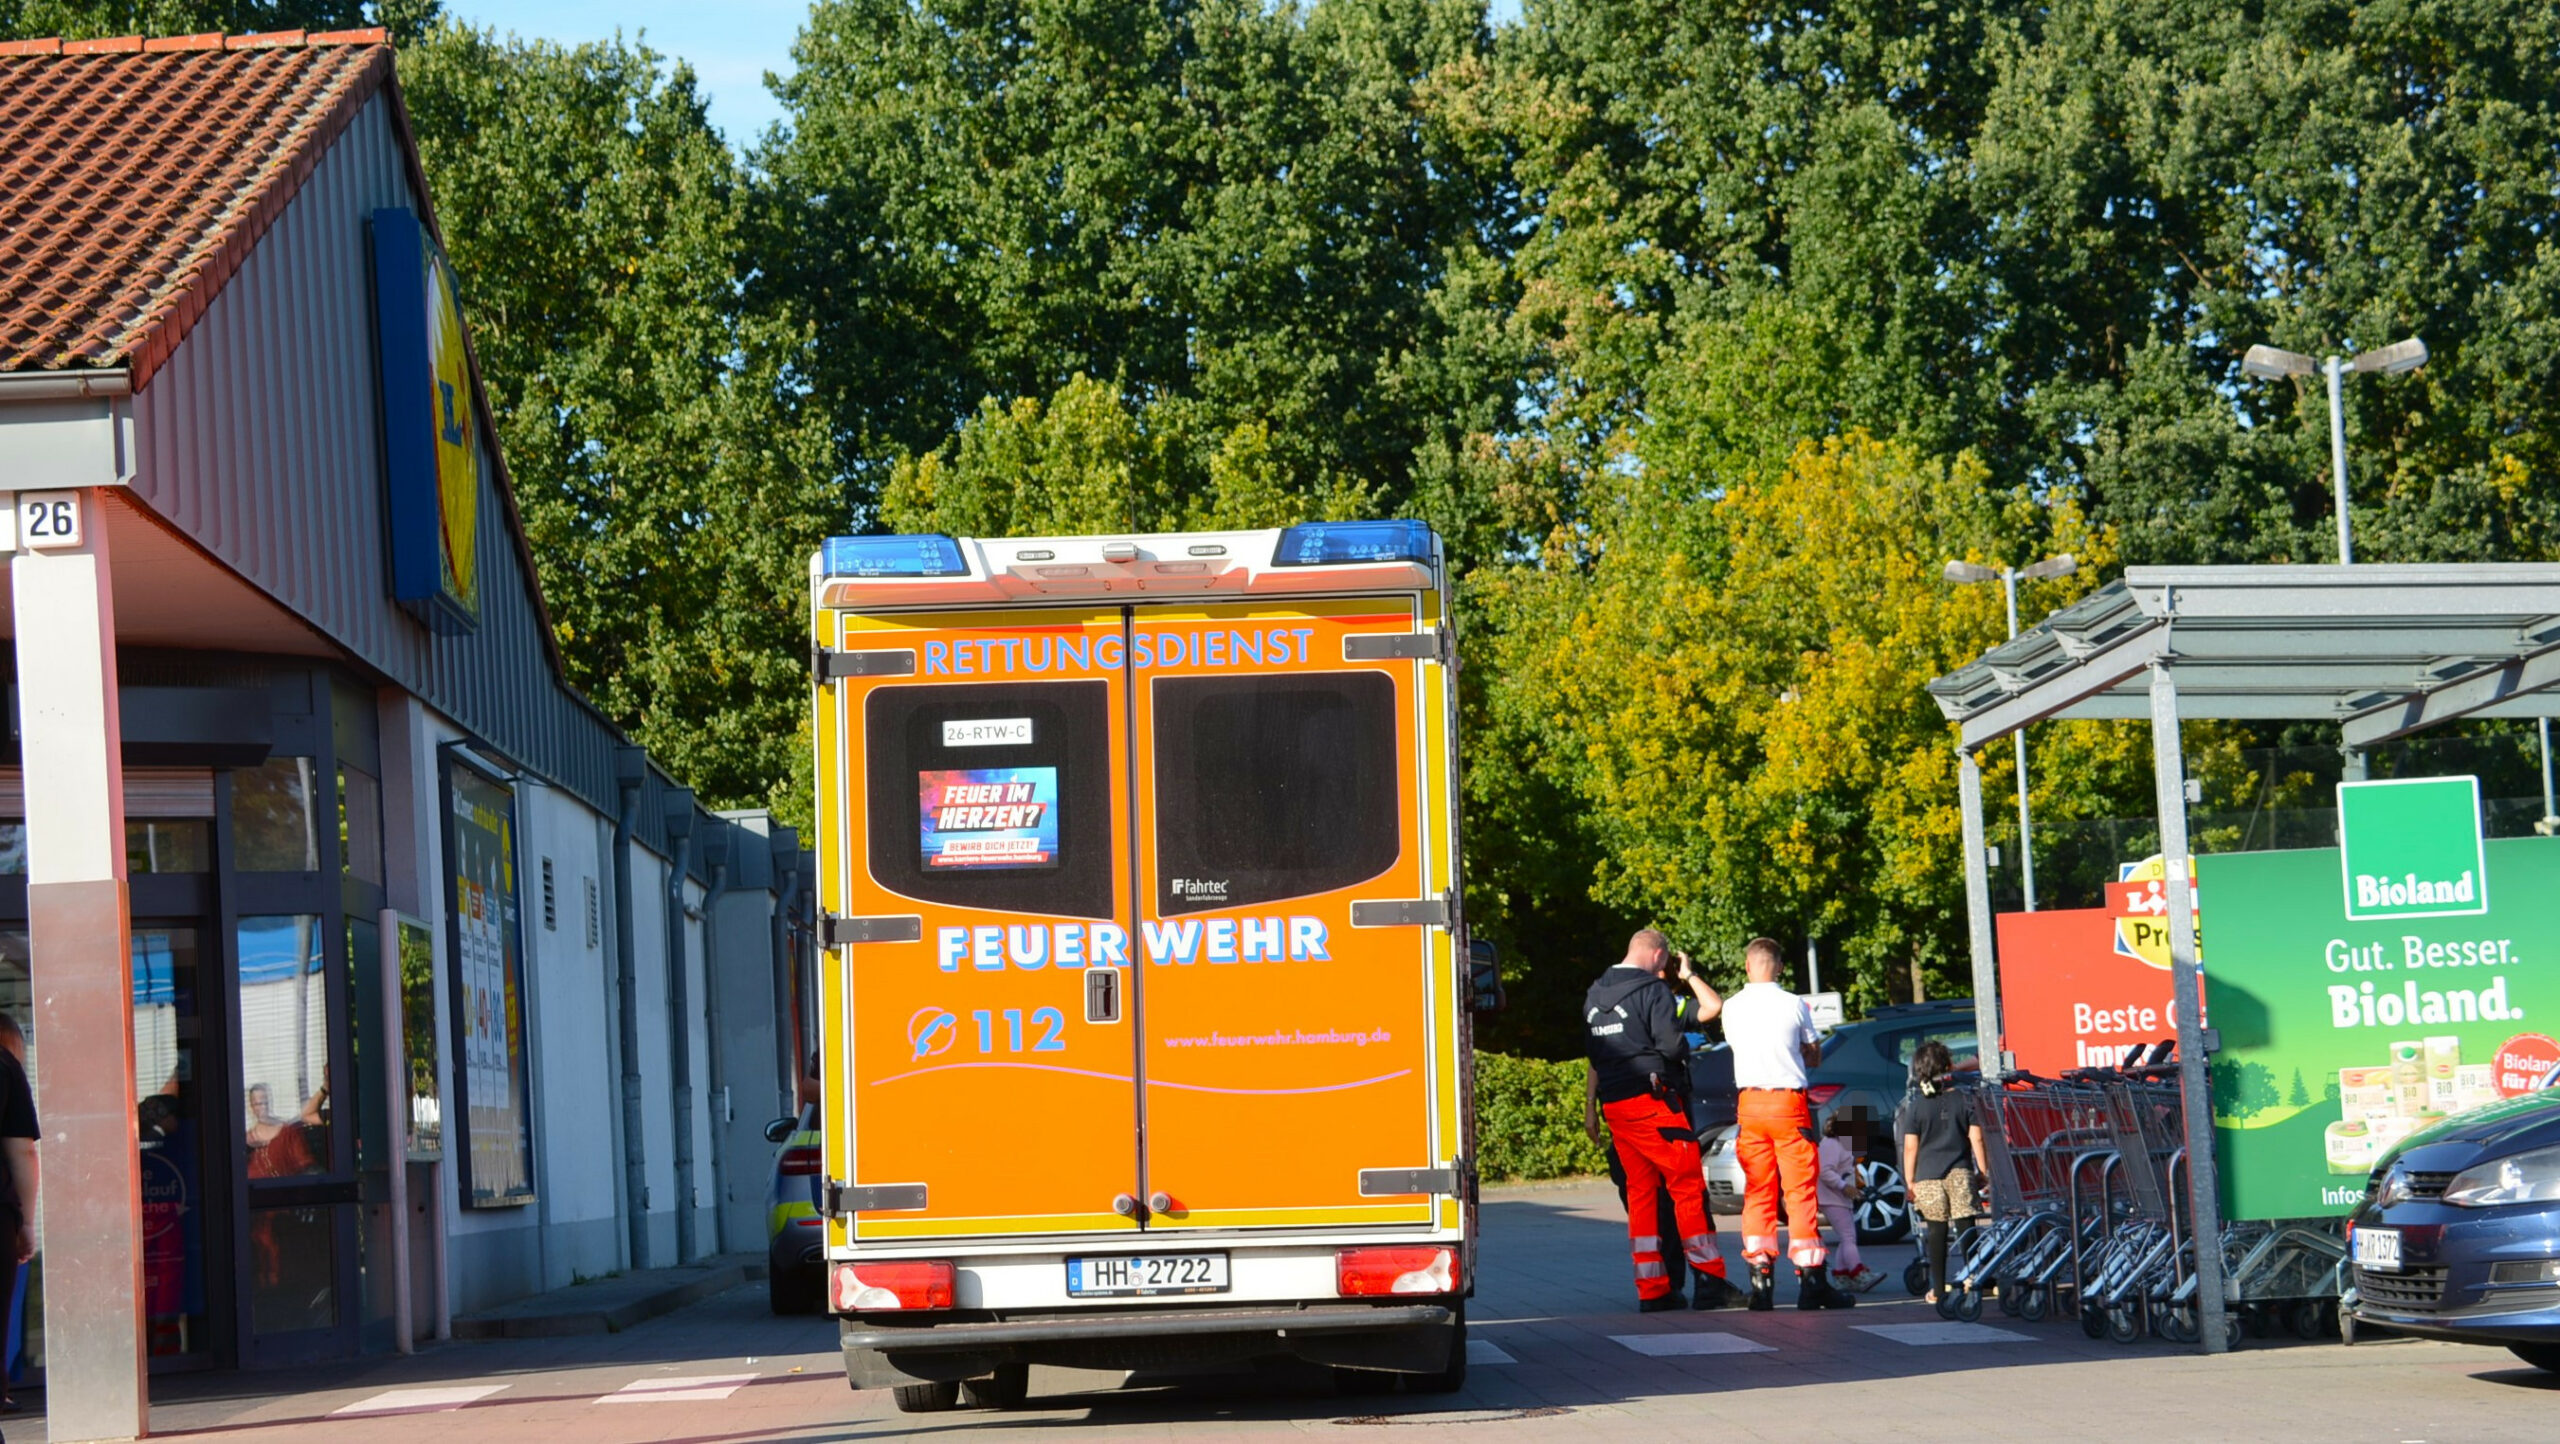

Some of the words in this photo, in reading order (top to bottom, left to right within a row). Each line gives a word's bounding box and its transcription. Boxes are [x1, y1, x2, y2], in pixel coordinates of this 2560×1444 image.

[29, 501, 73, 536] 26
[924, 629, 1313, 674] RETTUNGSDIENST
[947, 725, 1026, 740] 26-RTW-C
[944, 784, 1003, 804] FEUER
[1006, 783, 1031, 802] IM
[938, 805, 1040, 829] HERZEN?
[949, 842, 982, 852] BEWIRB
[985, 841, 1005, 851] DICH
[1008, 840, 1034, 851] JETZT!
[1185, 878, 1227, 894] fahrtec
[2356, 870, 2475, 907] Bioland
[2325, 938, 2394, 972] Gut.
[2401, 935, 2519, 969] Besser.
[2327, 976, 2524, 1028] Bioland.
[972, 1006, 1066, 1053] 112
[2073, 1002, 2157, 1035] Beste
[1164, 1027, 1391, 1047] www.feuerwehr.hamburg.de
[2503, 1052, 2553, 1073] Biolan
[2502, 1072, 2526, 1090] für
[2322, 1186, 2366, 1206] Infos
[1095, 1260, 1128, 1286] HH
[1148, 1258, 1211, 1285] 2722
